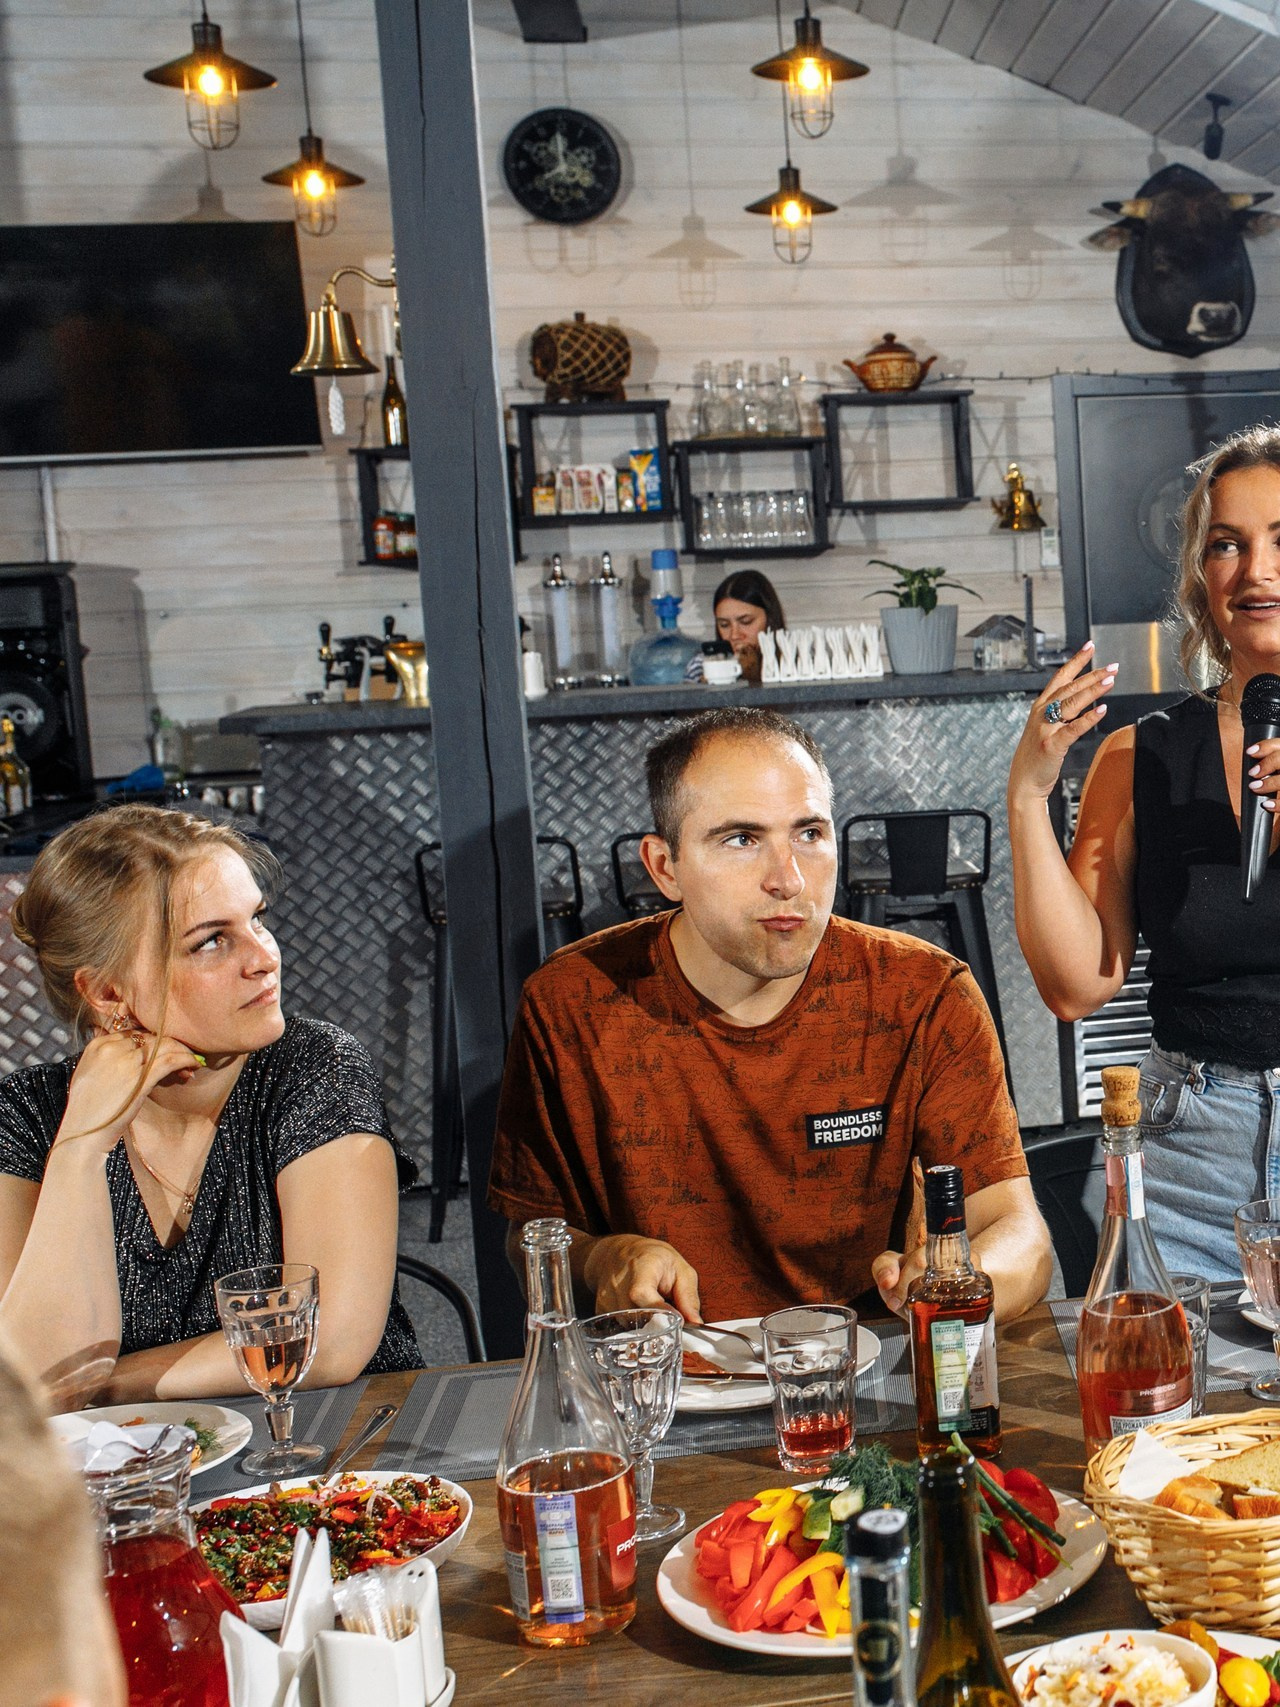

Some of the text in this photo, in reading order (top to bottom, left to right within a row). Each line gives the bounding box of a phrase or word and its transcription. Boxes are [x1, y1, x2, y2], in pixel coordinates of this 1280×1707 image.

[813, 1110, 883, 1130] BOUNDLESS
[814, 1123, 883, 1144] FREEDOM
[616, 1535, 636, 1556] PRO
